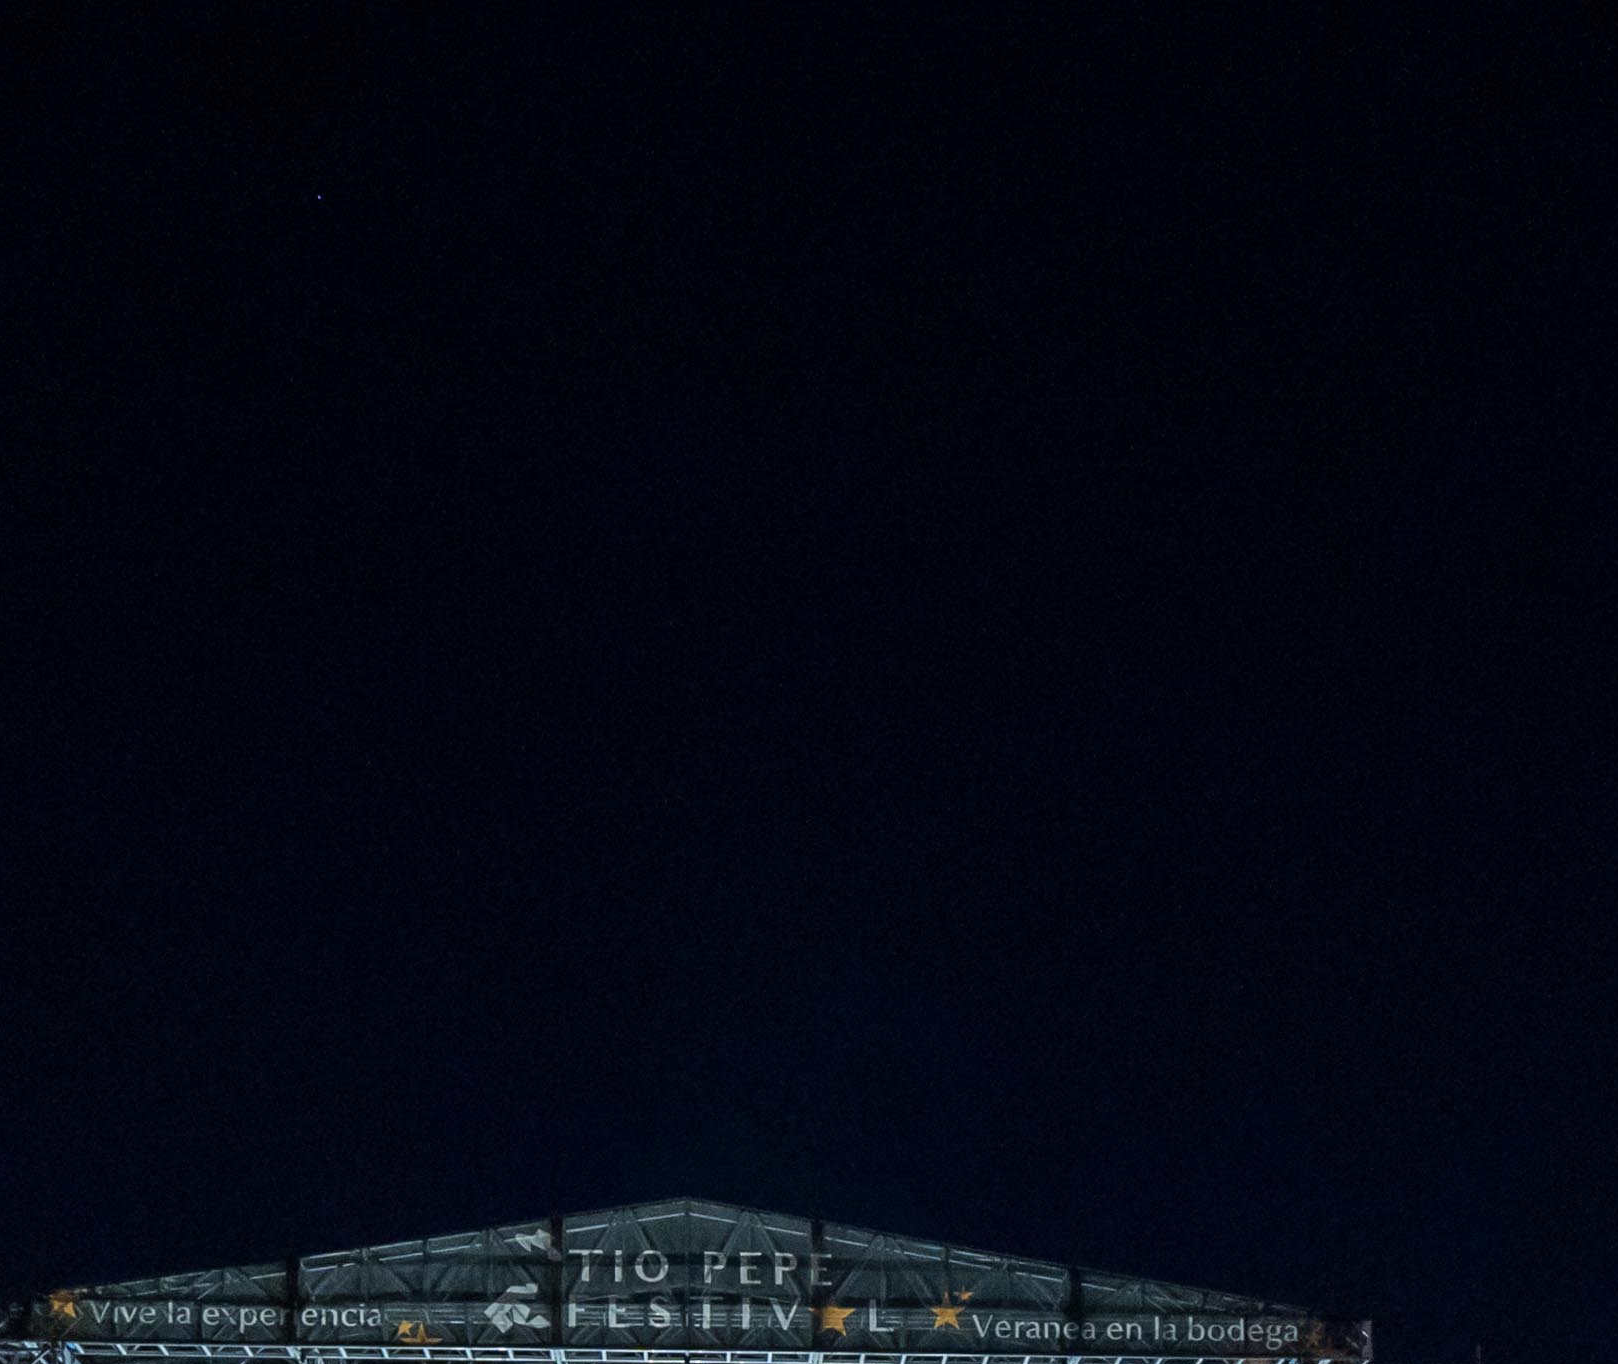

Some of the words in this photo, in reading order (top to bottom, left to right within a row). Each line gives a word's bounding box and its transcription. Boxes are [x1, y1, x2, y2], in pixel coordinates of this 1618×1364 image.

[567, 1249, 670, 1283] TIO
[703, 1251, 832, 1286] PEPE
[89, 1301, 157, 1324] Vive
[167, 1301, 192, 1324] la
[201, 1304, 382, 1334] experencia
[971, 1314, 1097, 1340] Veranea
[1106, 1320, 1142, 1340] en
[1154, 1315, 1179, 1341] la
[1187, 1315, 1300, 1350] bodega
